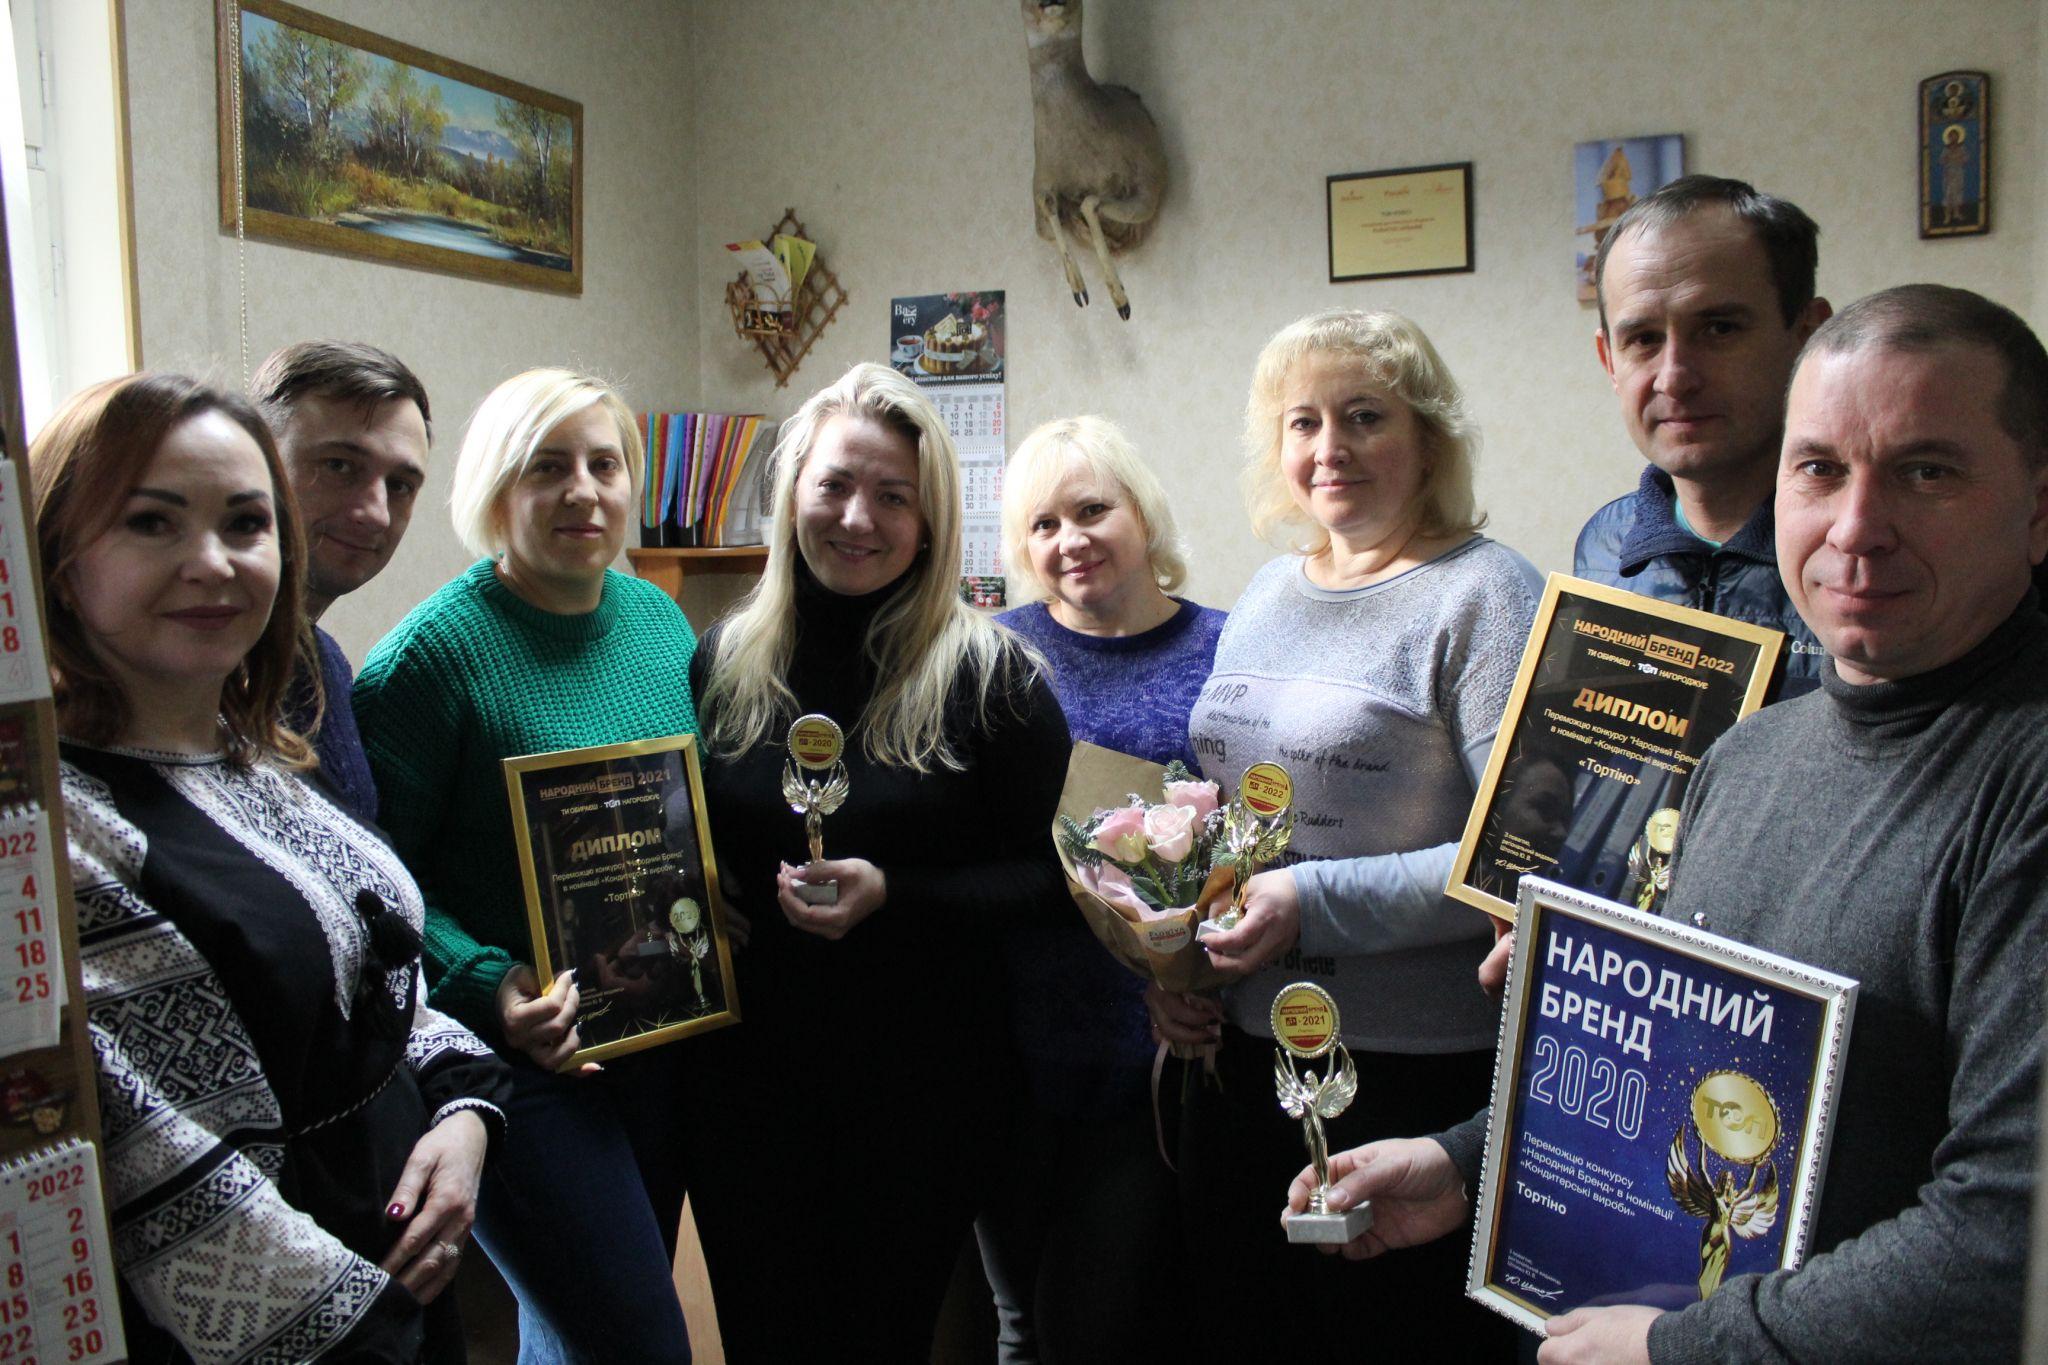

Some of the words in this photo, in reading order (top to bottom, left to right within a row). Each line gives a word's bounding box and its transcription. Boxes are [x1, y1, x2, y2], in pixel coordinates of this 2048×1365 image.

[950, 412, 959, 420] 10
[964, 412, 973, 420] 11
[950, 420, 959, 428] 17
[964, 420, 974, 428] 18
[950, 428, 959, 437] 24
[964, 428, 974, 436] 25
[965, 502, 974, 510] 30
[1573, 619, 1647, 651] НАРОДНИЙ
[1649, 641, 1696, 665] БРЕНД
[1698, 654, 1736, 674] 2022
[1596, 651, 1631, 668] ОБИРАЄШ
[1637, 662, 1659, 676] ТОП
[1658, 669, 1709, 690] НАГОРОДЖУЄ
[1206, 683, 1249, 705] MVP
[1543, 708, 1591, 730] Переможцю
[1591, 725, 1628, 742] конкурсу
[1572, 687, 1690, 738] ДИПЛОМ
[813, 739, 832, 748] 2020
[1556, 728, 1593, 745] номінації
[1593, 738, 1652, 765] «Кондитерські
[1651, 757, 1687, 775] вироби»
[540, 781, 598, 799] НАРОДНИЙ
[599, 778, 633, 790] БРЕНД
[638, 768, 671, 786] 2021
[1578, 756, 1642, 786] «Тортіно»
[1262, 785, 1284, 799] 2022
[571, 827, 662, 863] ДИПЛОМ
[22, 874, 37, 900] 4
[15, 907, 43, 935] 11
[15, 940, 47, 969] 18
[17, 972, 50, 1003] 25
[1546, 931, 1775, 1044] НАРОДНИЙ
[1302, 1015, 1325, 1026] 2021
[1540, 982, 1653, 1062] БРЕНД
[1530, 1034, 1647, 1140] 2020
[1702, 1095, 1768, 1140] ТОП
[1523, 1131, 1584, 1165] Переможцю
[1586, 1160, 1634, 1189] конкурсу
[27, 1164, 85, 1202] 2022
[1516, 1180, 1567, 1215] Тортіно
[1520, 1159, 1591, 1198] «Кондитерські
[1592, 1192, 1636, 1217] вироби»
[1521, 1146, 1576, 1177] «Народний
[1577, 1170, 1614, 1194] Бренд»
[1616, 1188, 1624, 1198] в
[1625, 1191, 1675, 1220] номінації
[7, 1230, 21, 1255] 1
[67, 1207, 85, 1233] 2
[8, 1262, 25, 1290] 8
[71, 1237, 89, 1264] 9
[63, 1267, 94, 1298] 16
[63, 1298, 98, 1332] 23
[67, 1329, 104, 1362] 30
